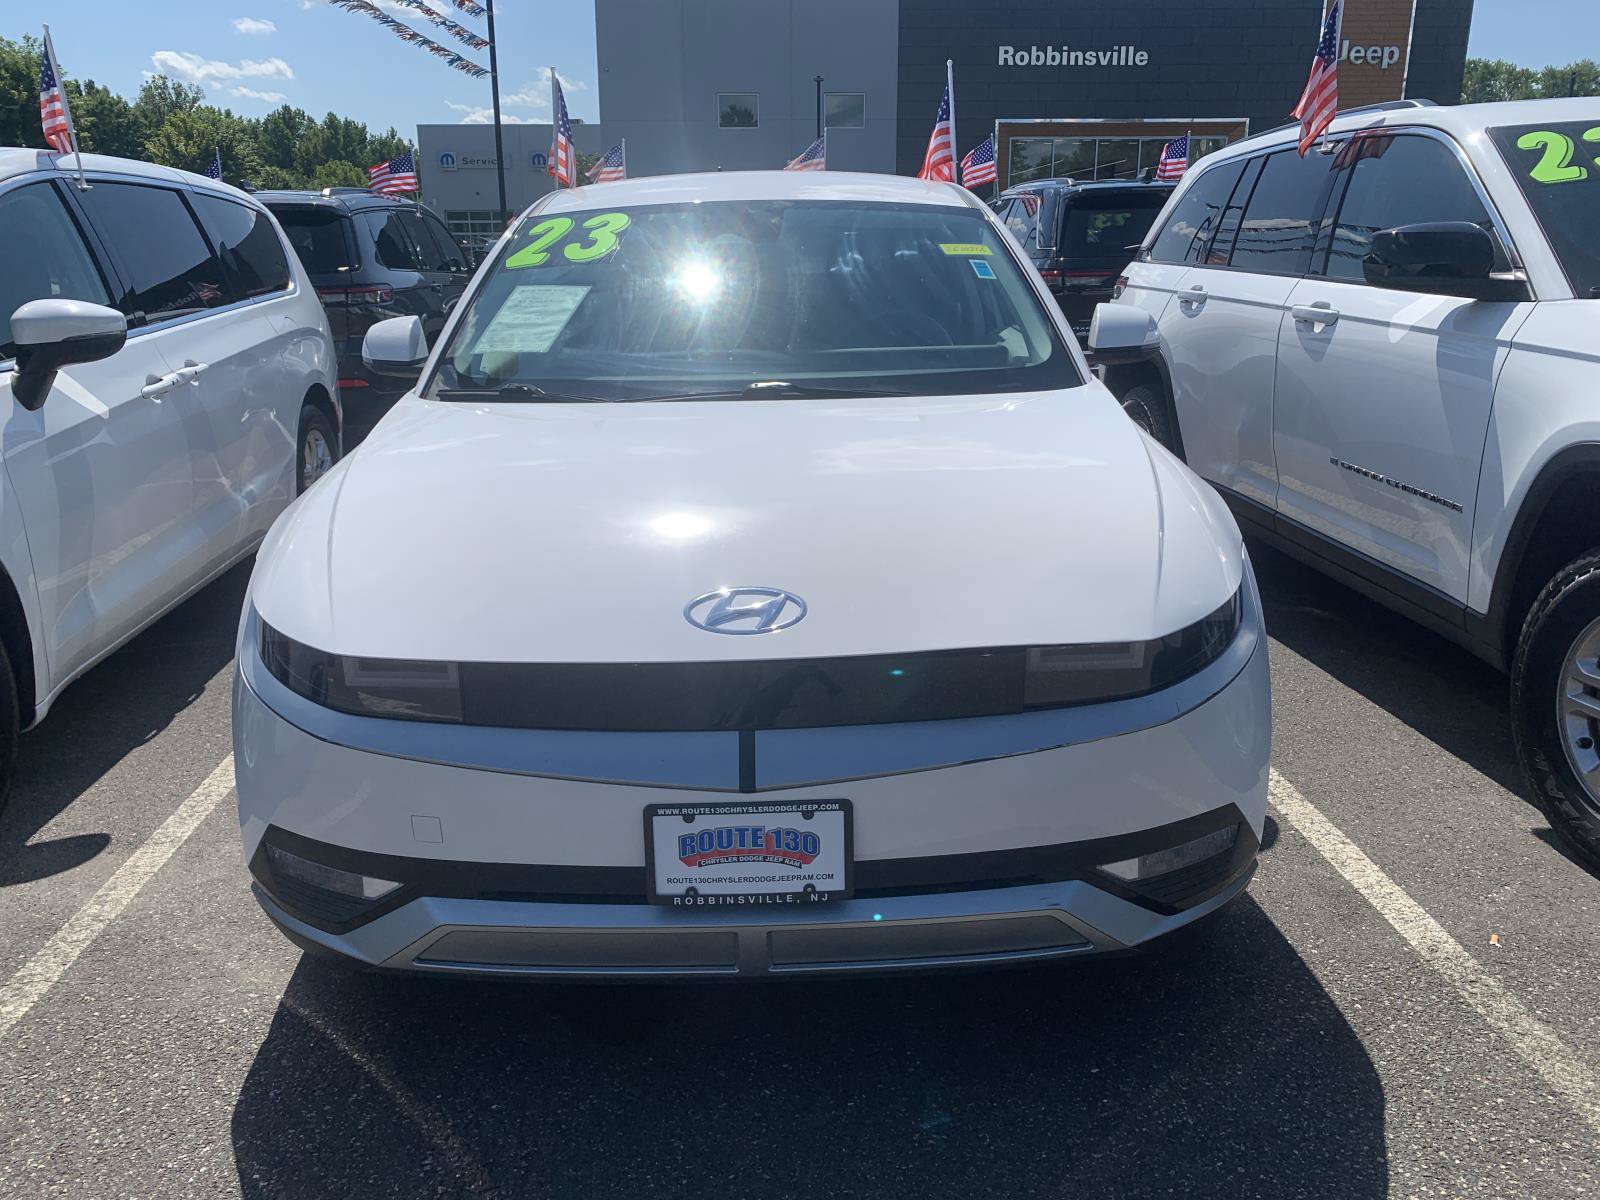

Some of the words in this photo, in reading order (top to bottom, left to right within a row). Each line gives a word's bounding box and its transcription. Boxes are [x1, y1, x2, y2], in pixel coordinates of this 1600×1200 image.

[998, 45, 1149, 66] Robbinsville
[1338, 40, 1400, 69] Jeep
[462, 156, 501, 166] Servic
[506, 212, 631, 269] 23
[657, 803, 840, 815] WWW.ROUTE130CHRYSLERDODGEJEEP.COM
[678, 825, 766, 857] ROUTE
[769, 827, 821, 856] 130
[700, 856, 738, 866] CHRYSLER
[739, 855, 764, 863] DODGE
[765, 856, 783, 864] JEEP
[784, 858, 801, 867] RAM
[666, 873, 835, 885] ROUTE130CHRYSLERDODGEJEEPRAM.COM
[673, 894, 801, 905] ROBBINSVILLE,
[810, 893, 829, 902] NJ
